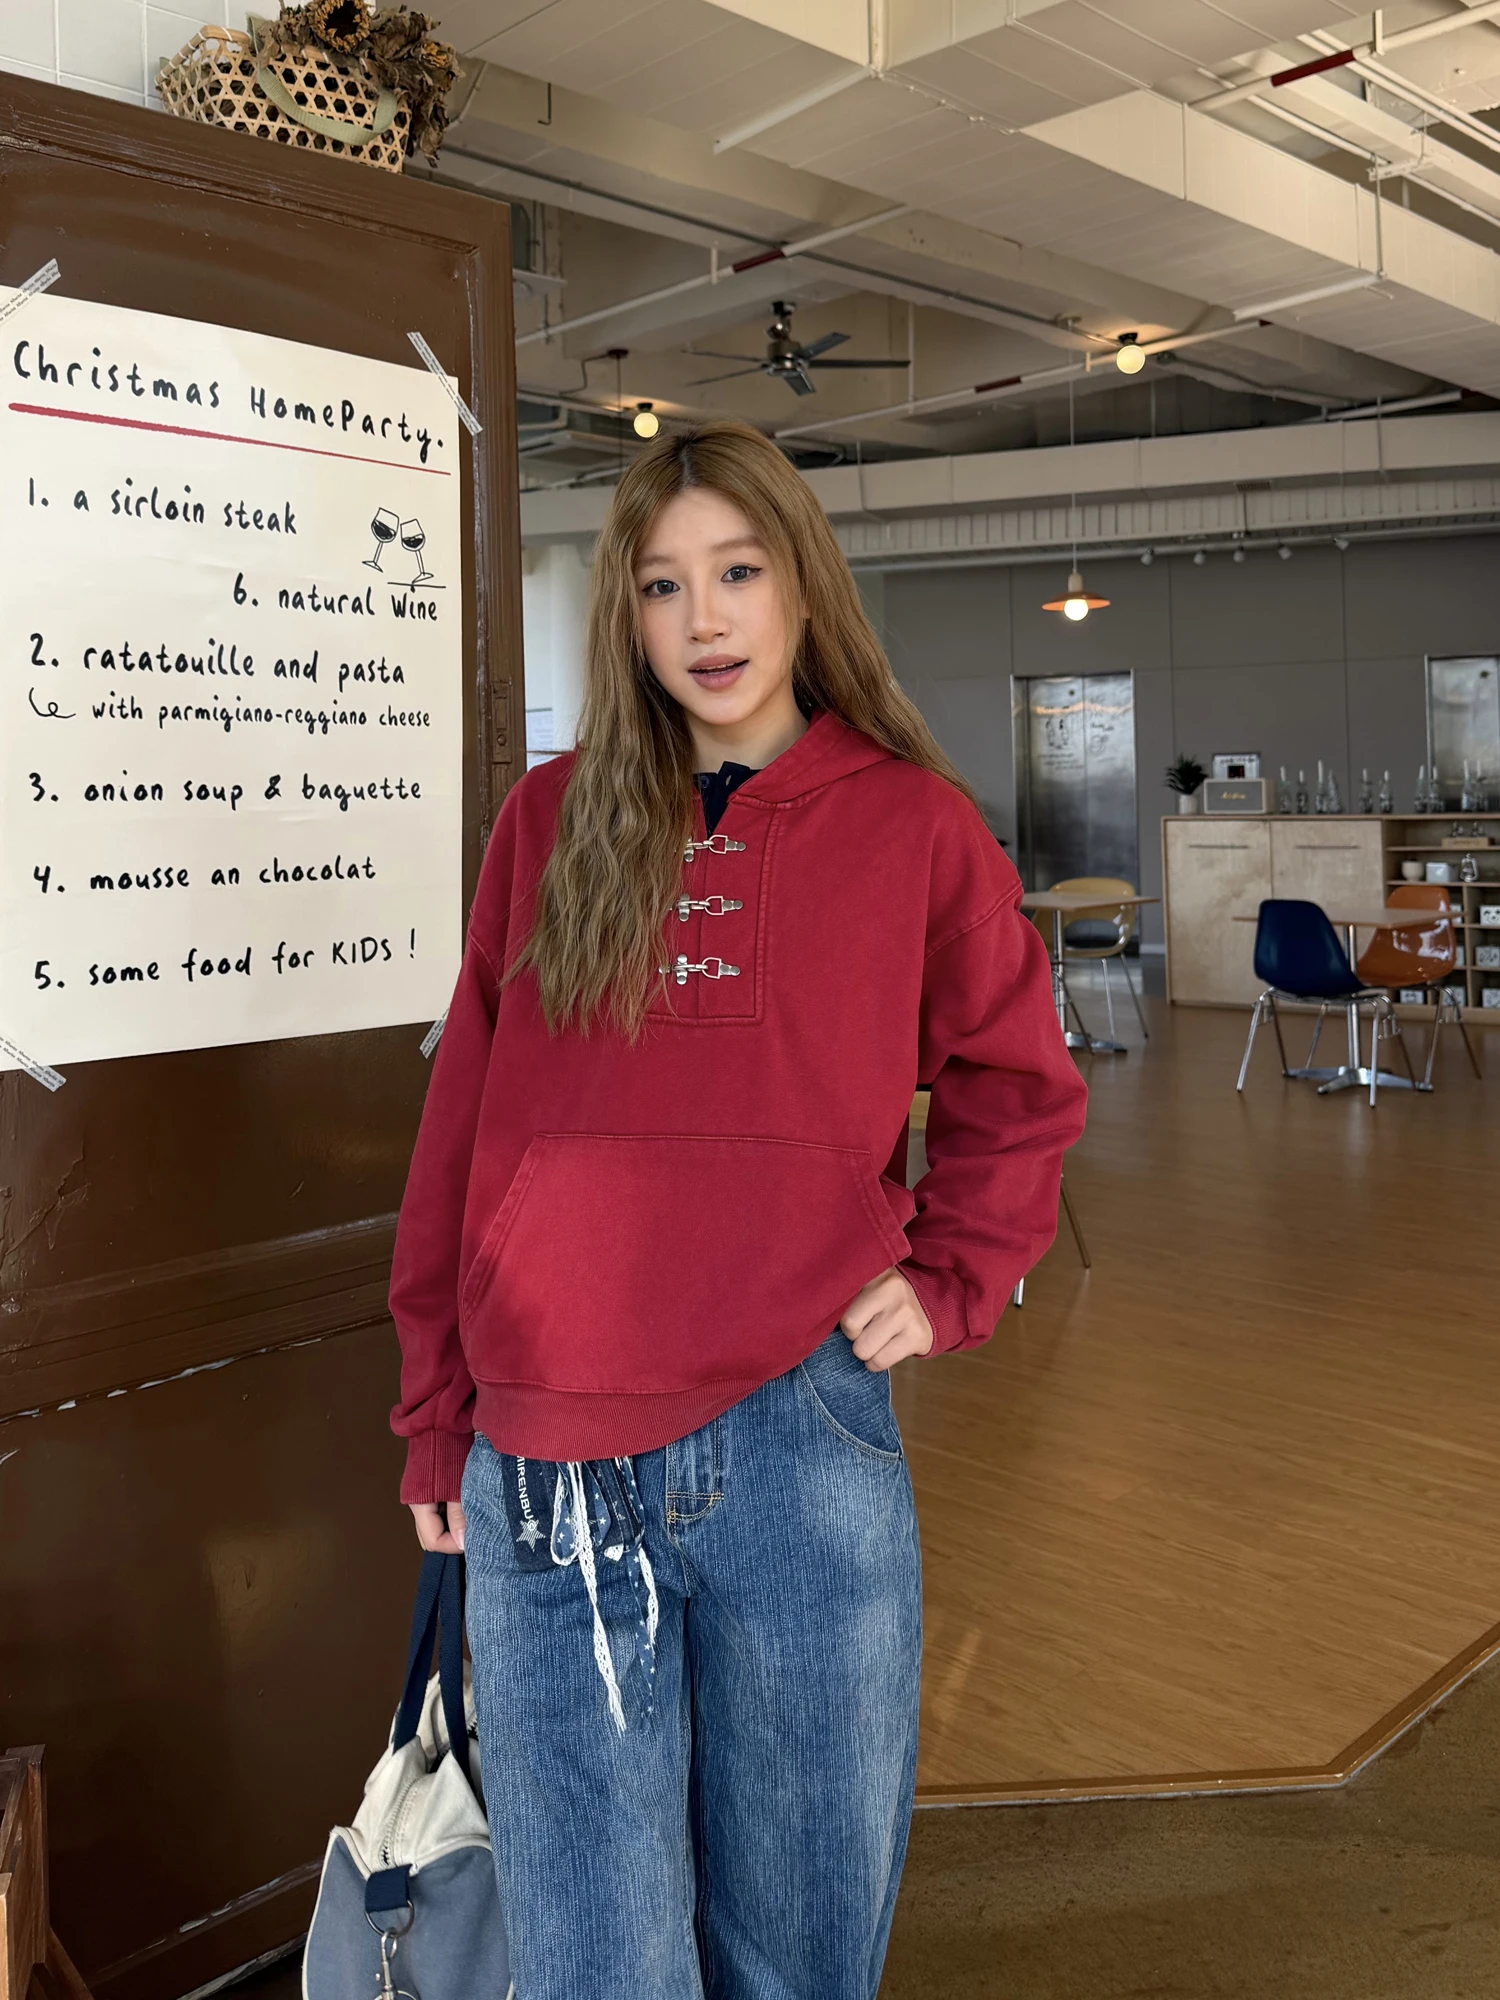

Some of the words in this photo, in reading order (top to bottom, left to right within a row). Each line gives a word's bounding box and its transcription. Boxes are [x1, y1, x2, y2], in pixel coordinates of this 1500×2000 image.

[13, 340, 220, 408] Christmas
[29, 477, 49, 507] 1.
[73, 490, 89, 511] a
[111, 477, 205, 524] sirloin
[223, 500, 297, 535] steak
[233, 572, 259, 607] 6.
[278, 584, 375, 616] natural
[30, 632, 59, 668] 2.
[83, 637, 255, 677] ratatouille
[273, 650, 319, 684] and
[338, 656, 405, 693] pasta
[92, 690, 143, 720] with
[158, 694, 367, 735] parmigiano-reggiano
[379, 704, 430, 727] cheese
[28, 772, 59, 802] 3.
[84, 769, 164, 802] onion
[183, 780, 243, 811] soup
[264, 774, 282, 800] &
[301, 772, 421, 812] baguette
[33, 865, 66, 894] 4.
[90, 866, 190, 890] mousse
[211, 867, 240, 886] an
[258, 854, 376, 884] chocolat
[34, 960, 65, 990] 5.
[88, 961, 160, 986] some
[181, 946, 252, 983] food
[271, 941, 315, 975] for
[332, 936, 392, 965] KIDS
